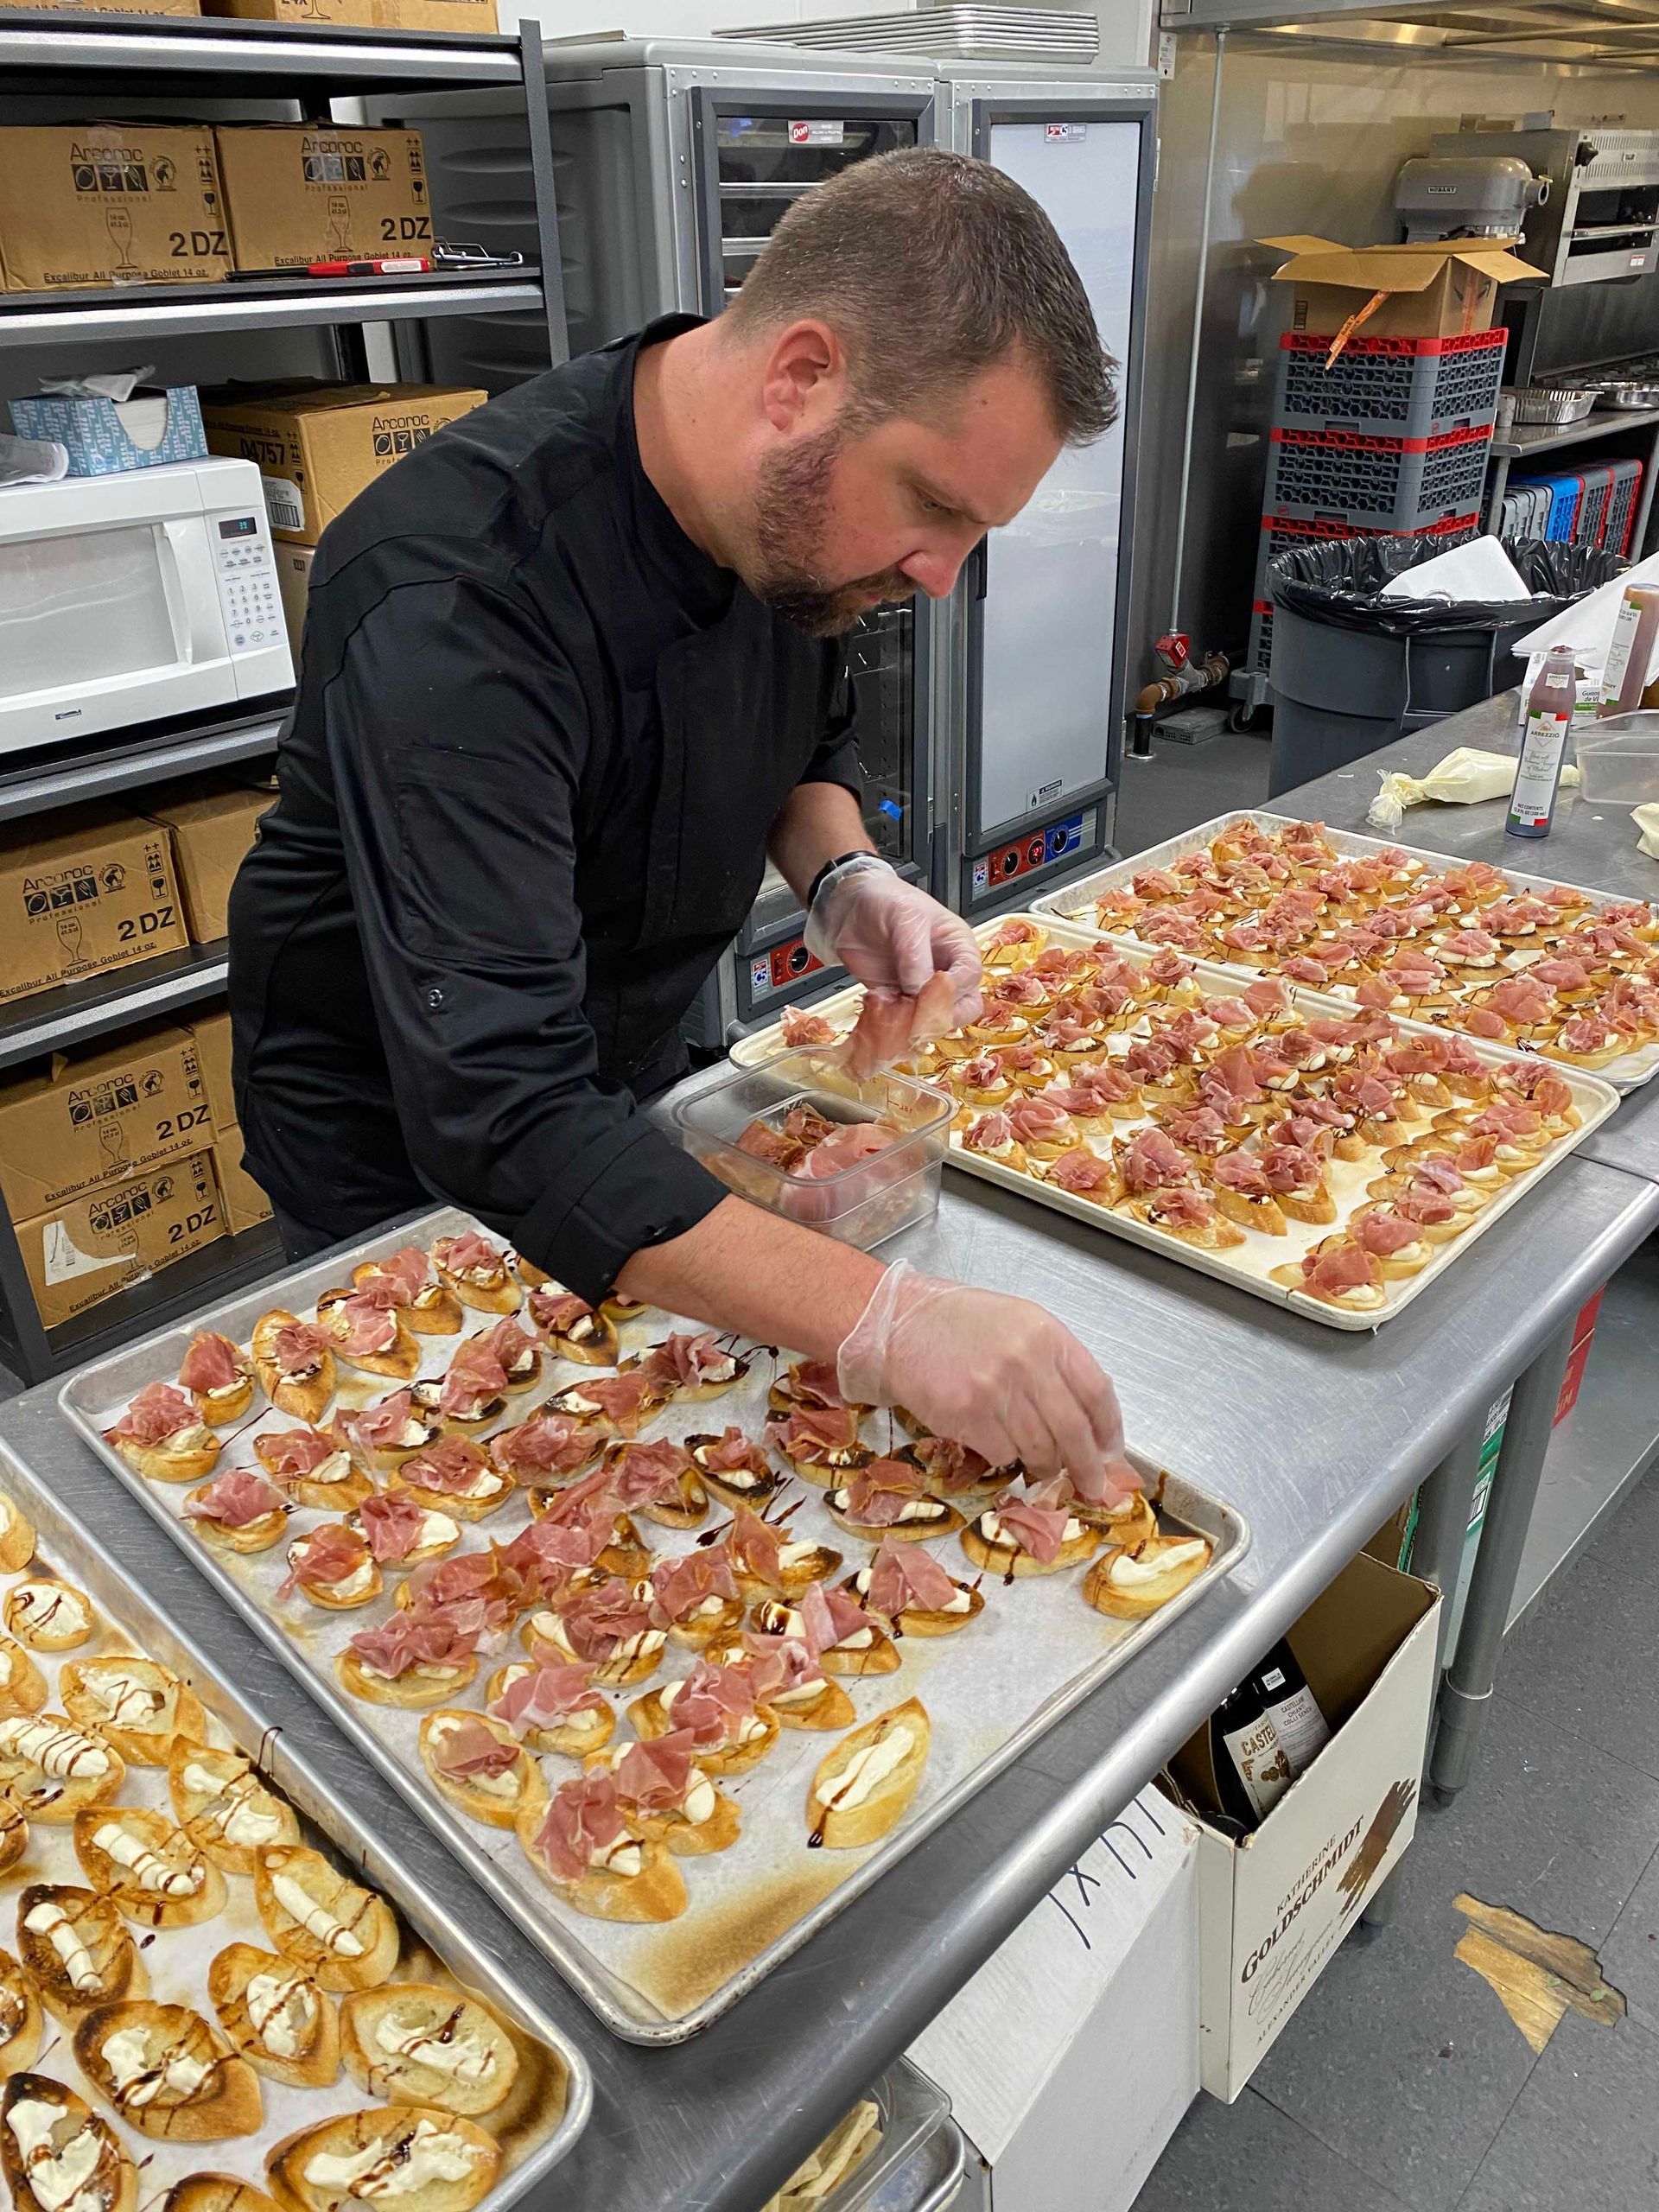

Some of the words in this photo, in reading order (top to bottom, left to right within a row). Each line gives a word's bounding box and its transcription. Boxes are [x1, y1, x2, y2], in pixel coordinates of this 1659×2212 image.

[302, 137, 363, 154] Arcoroc
[794, 125, 808, 138] Don
[70, 143, 143, 162] Arcoroc
[381, 218, 397, 240] 2
[400, 217, 431, 240] DZ
[168, 232, 188, 257] 2
[191, 232, 228, 256] DZ
[274, 256, 312, 264] Excalibur
[328, 253, 361, 263] Purpose
[44, 271, 89, 282] Excalibur
[93, 270, 105, 279] All
[150, 269, 181, 277] Goblet
[372, 415, 429, 432] Arcoroc
[240, 438, 285, 465] 04757
[22, 865, 94, 893] Arcoroc
[29, 899, 102, 925] Professional
[118, 920, 137, 942] 2
[139, 906, 175, 935] DZ
[0, 978, 43, 998] Excalibur
[46, 972, 58, 983] All
[60, 961, 98, 977] Purpose
[100, 950, 130, 964] Goblet
[132, 945, 142, 954] 14
[67, 1073, 134, 1105] Arcoroc
[73, 1103, 141, 1133] Professional
[156, 1120, 175, 1141] 2
[176, 1104, 211, 1133] DZ
[44, 1181, 86, 1202] Excalibur
[88, 1174, 100, 1184] All
[102, 1160, 137, 1179] Purpose
[140, 1148, 167, 1164] Goblet
[168, 1142, 180, 1151] 14
[88, 1181, 147, 1217] Arcoroc
[168, 1224, 185, 1244] 2
[186, 1204, 216, 1234] DZ
[69, 1290, 106, 1313] Excalibur
[108, 1281, 119, 1292] All
[154, 1250, 178, 1266] Goblet
[191, 1238, 202, 1247] oz.
[1283, 1715, 1299, 1726] COLLI
[1276, 1834, 1337, 1916] KATHERINE
[1241, 1815, 1363, 1983] GOLDSCHMIDT
[1257, 1975, 1306, 2044] ALEXANDER
[1307, 1934, 1335, 1973] VALLEY
